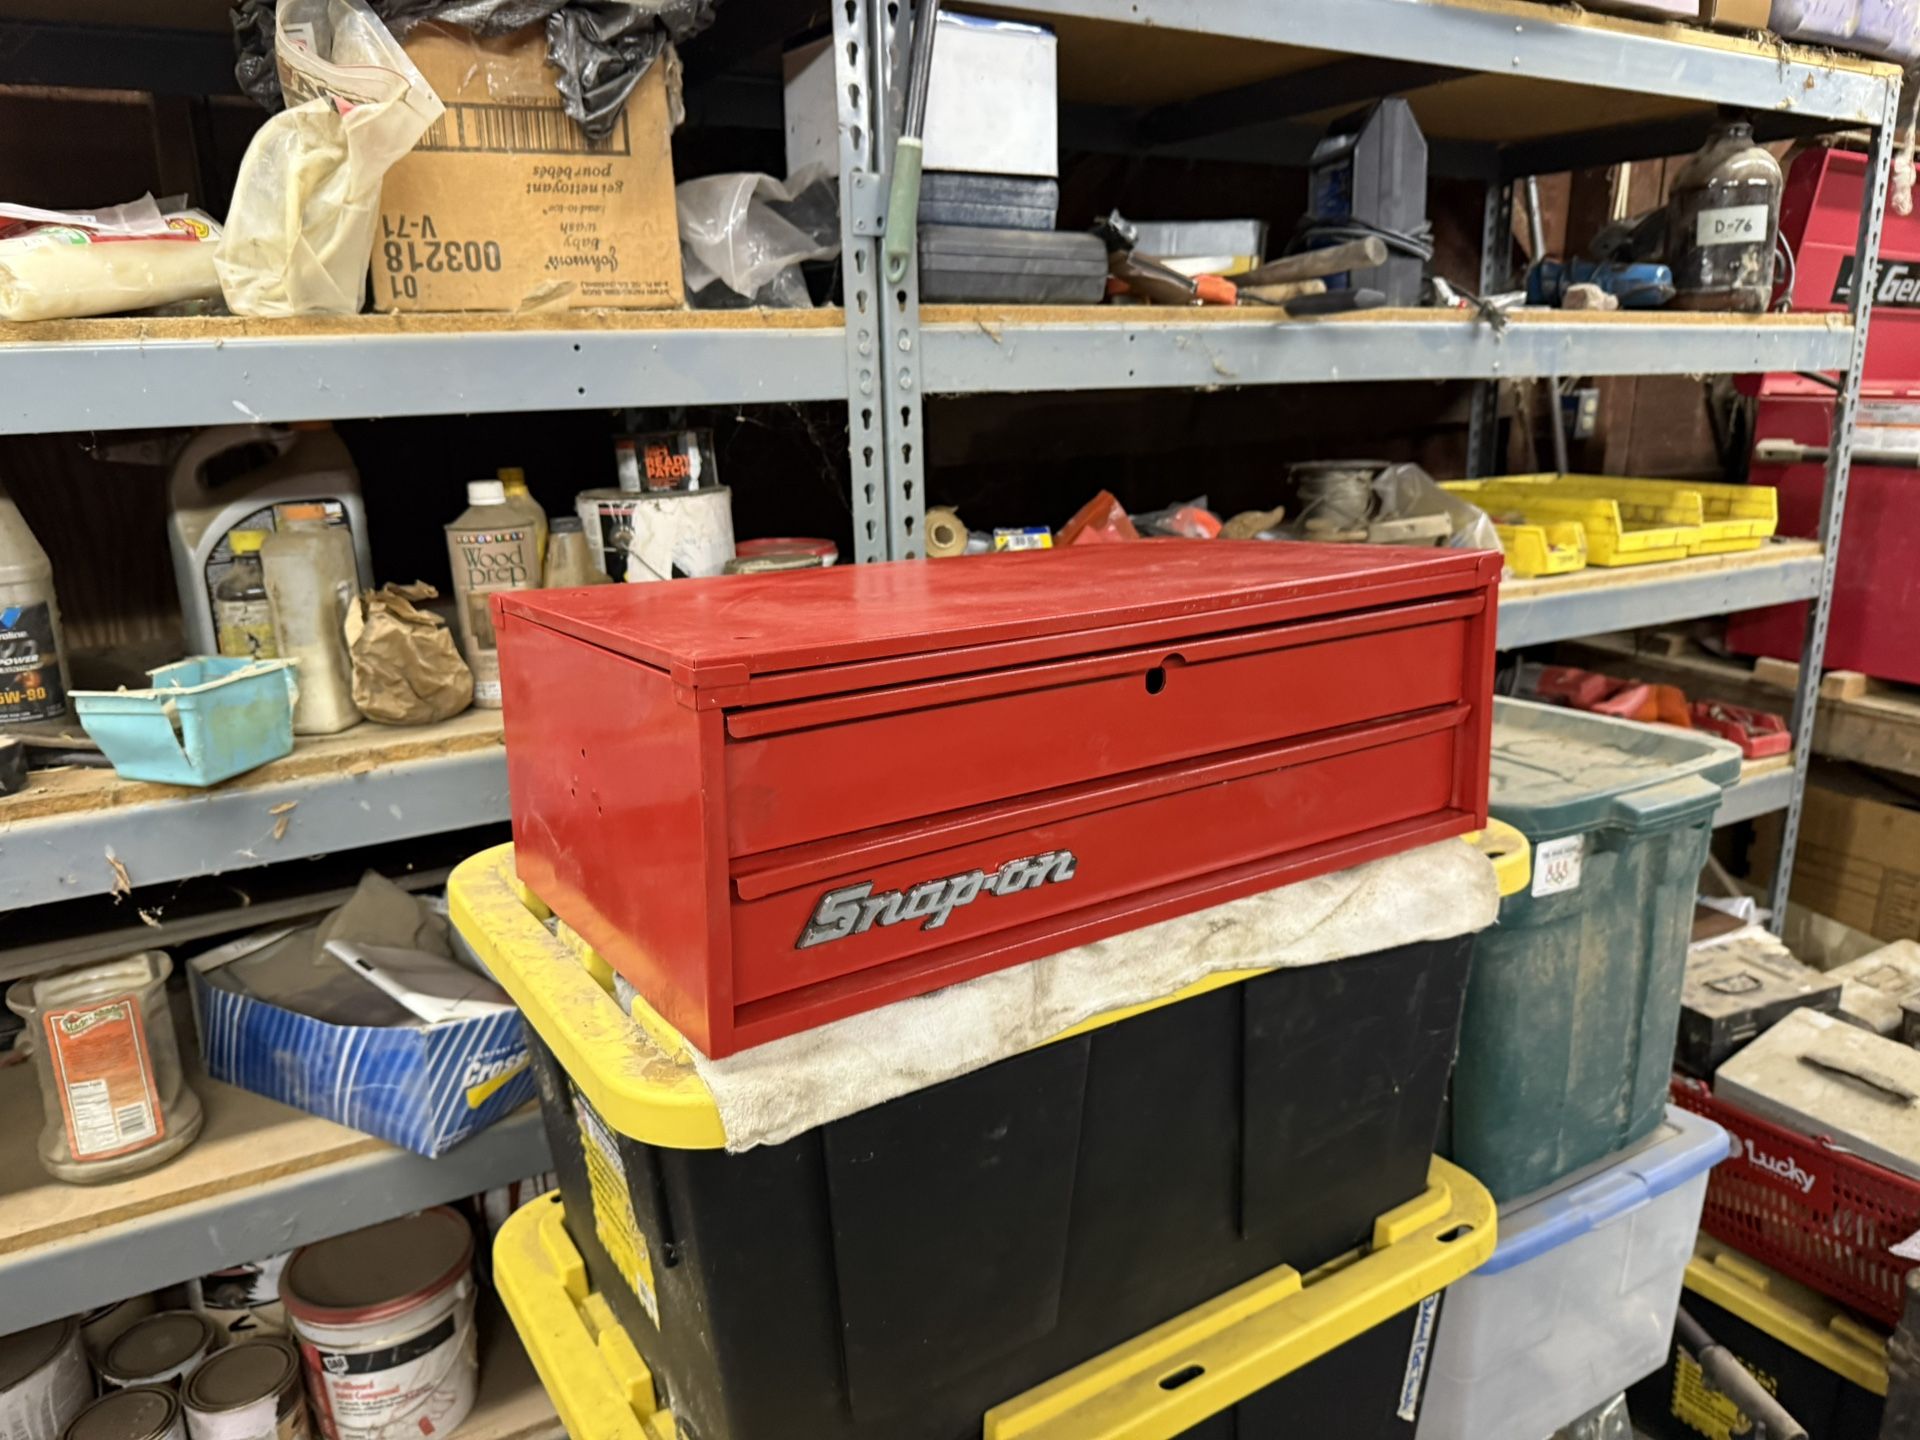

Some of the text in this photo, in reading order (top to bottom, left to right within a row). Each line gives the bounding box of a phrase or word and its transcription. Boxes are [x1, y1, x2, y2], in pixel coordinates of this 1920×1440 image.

[574, 164, 612, 177] pour
[526, 181, 600, 194] nettoyant
[382, 214, 437, 239] V-71
[560, 222, 597, 233] wash
[1715, 217, 1752, 233] D-76
[563, 234, 600, 249] baby
[385, 240, 501, 273] 003218
[391, 274, 418, 299] 01
[647, 465, 689, 478] PATCH
[462, 544, 524, 567] Wood
[468, 566, 527, 590] prep
[795, 848, 1078, 950] Snap-on
[1744, 1139, 1815, 1193] Lucky
